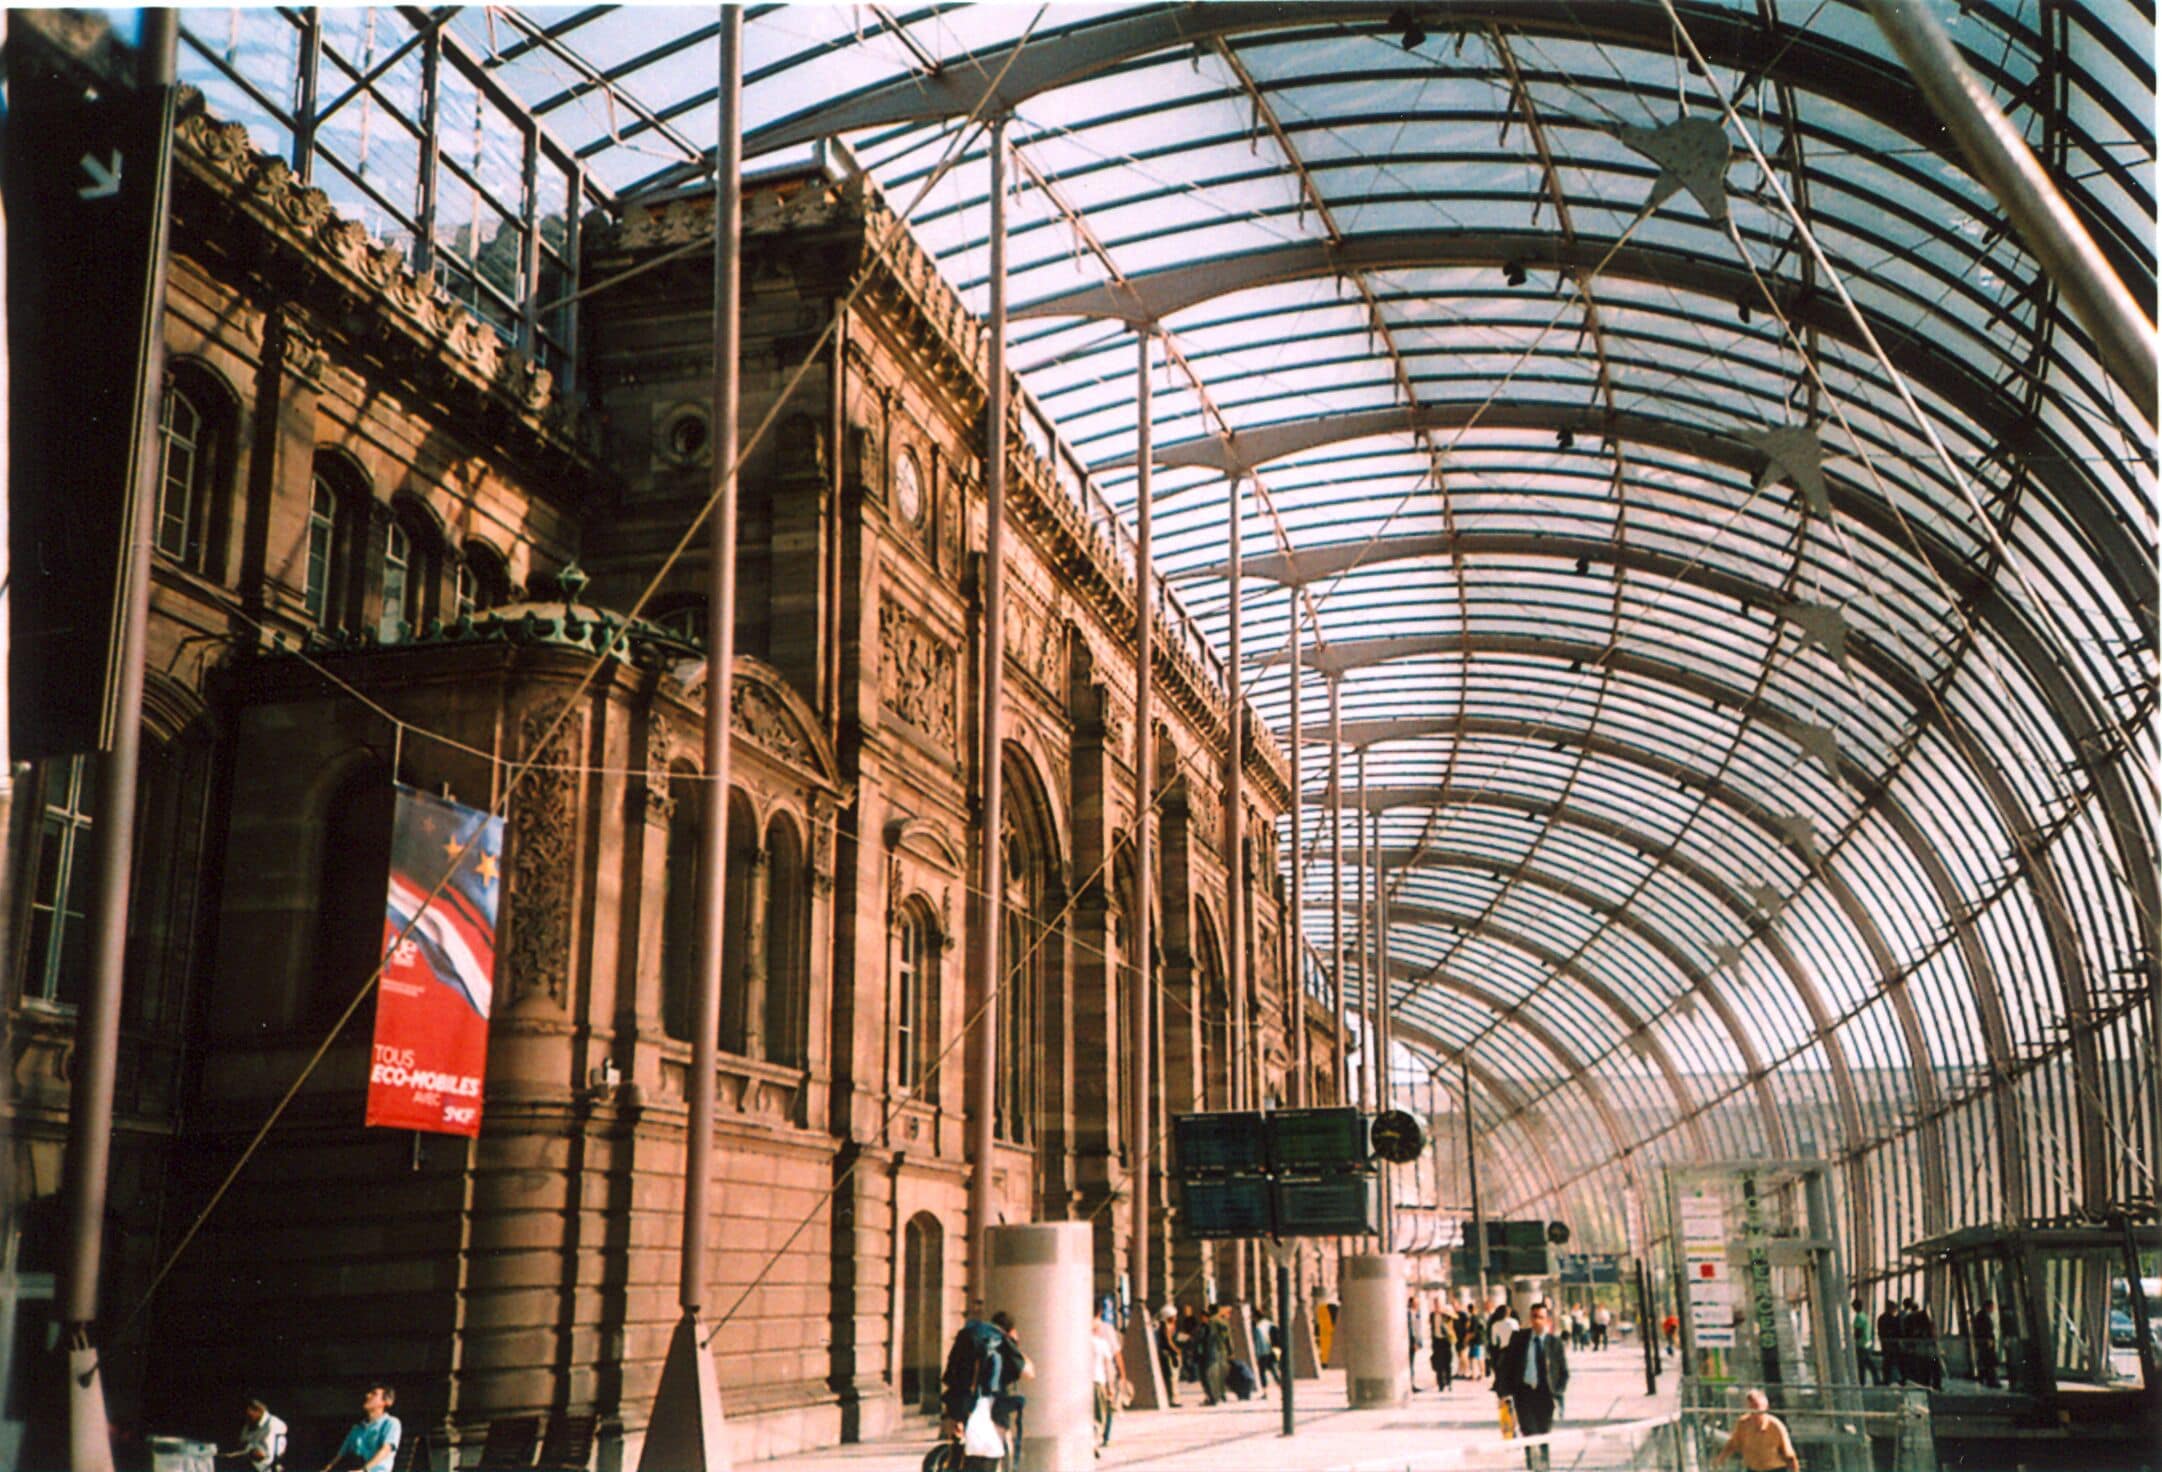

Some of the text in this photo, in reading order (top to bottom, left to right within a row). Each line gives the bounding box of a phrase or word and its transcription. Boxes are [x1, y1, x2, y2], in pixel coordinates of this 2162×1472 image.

[374, 1043, 415, 1069] TOUS
[371, 1064, 480, 1098] ECO-MOBILES
[413, 1091, 441, 1107] AVEC
[443, 1106, 476, 1124] SNCF
